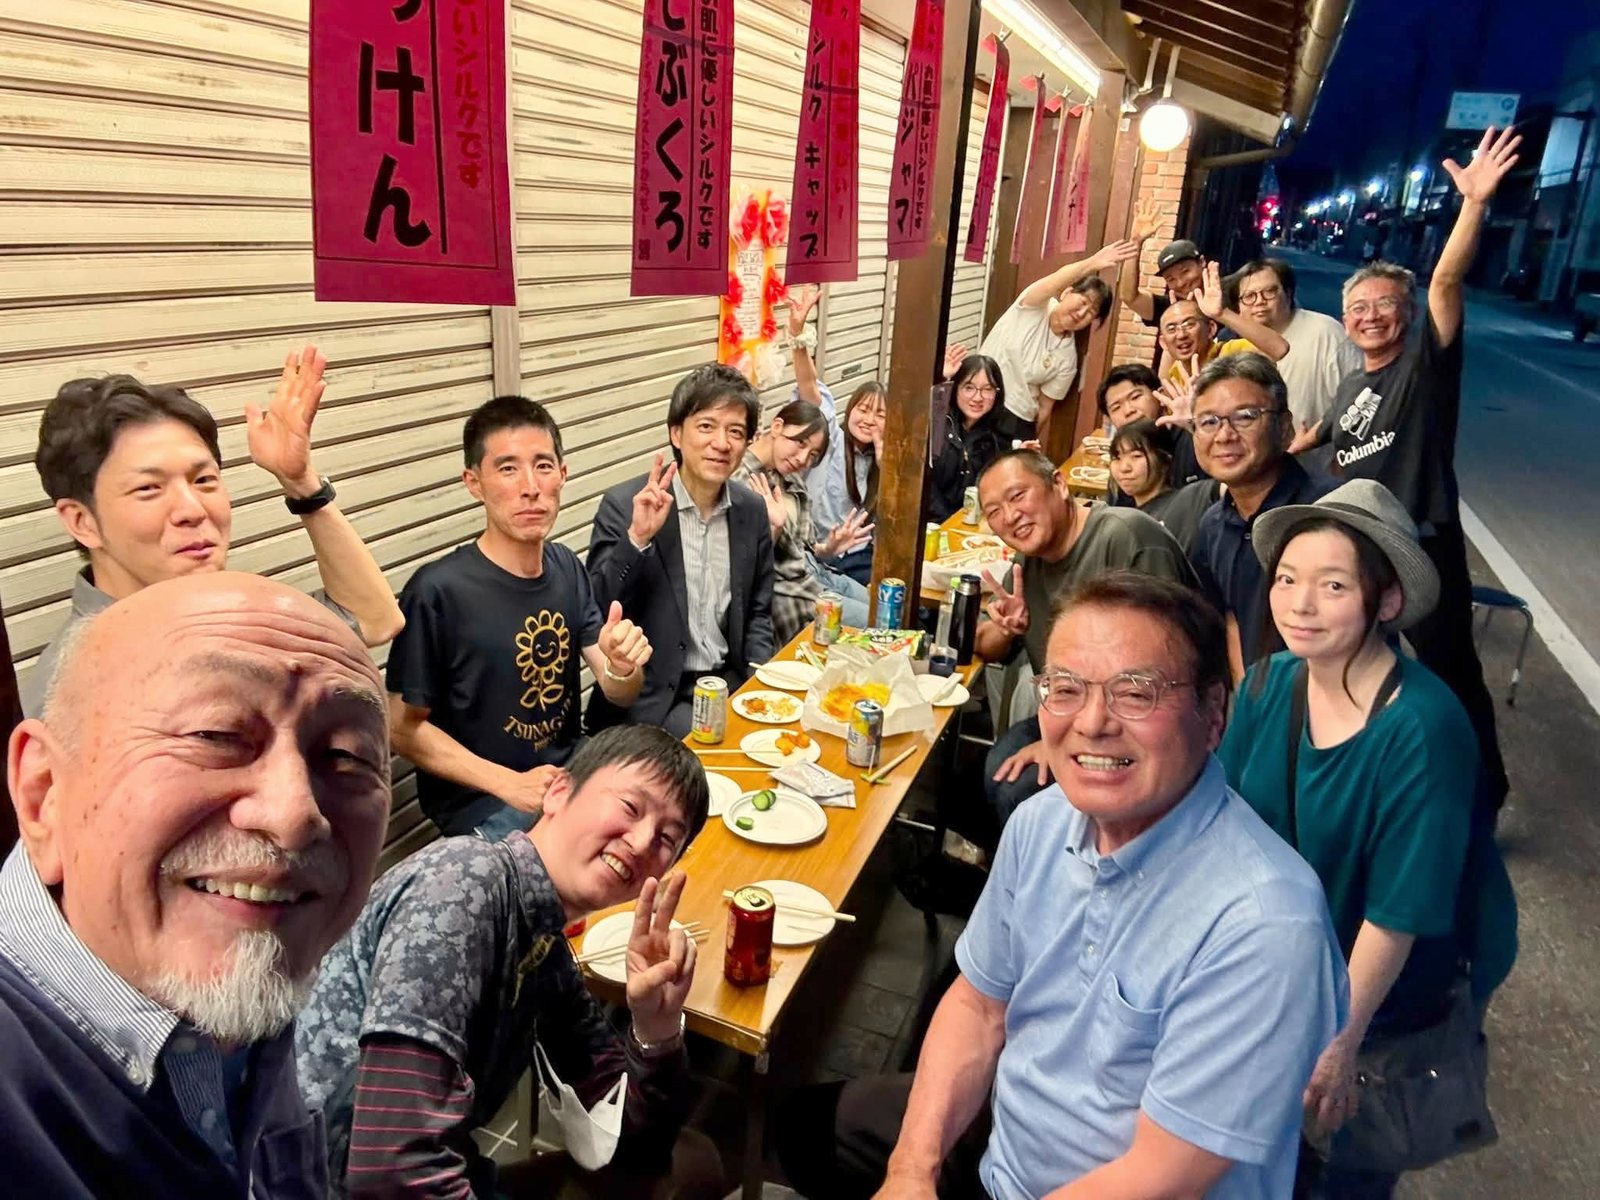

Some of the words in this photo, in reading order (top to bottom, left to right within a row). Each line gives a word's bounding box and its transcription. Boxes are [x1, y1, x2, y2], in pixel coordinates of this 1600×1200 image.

[453, 0, 484, 189] いシルクです
[697, 0, 718, 250] 肌に優しいシルクです
[895, 62, 919, 234] パジャマ
